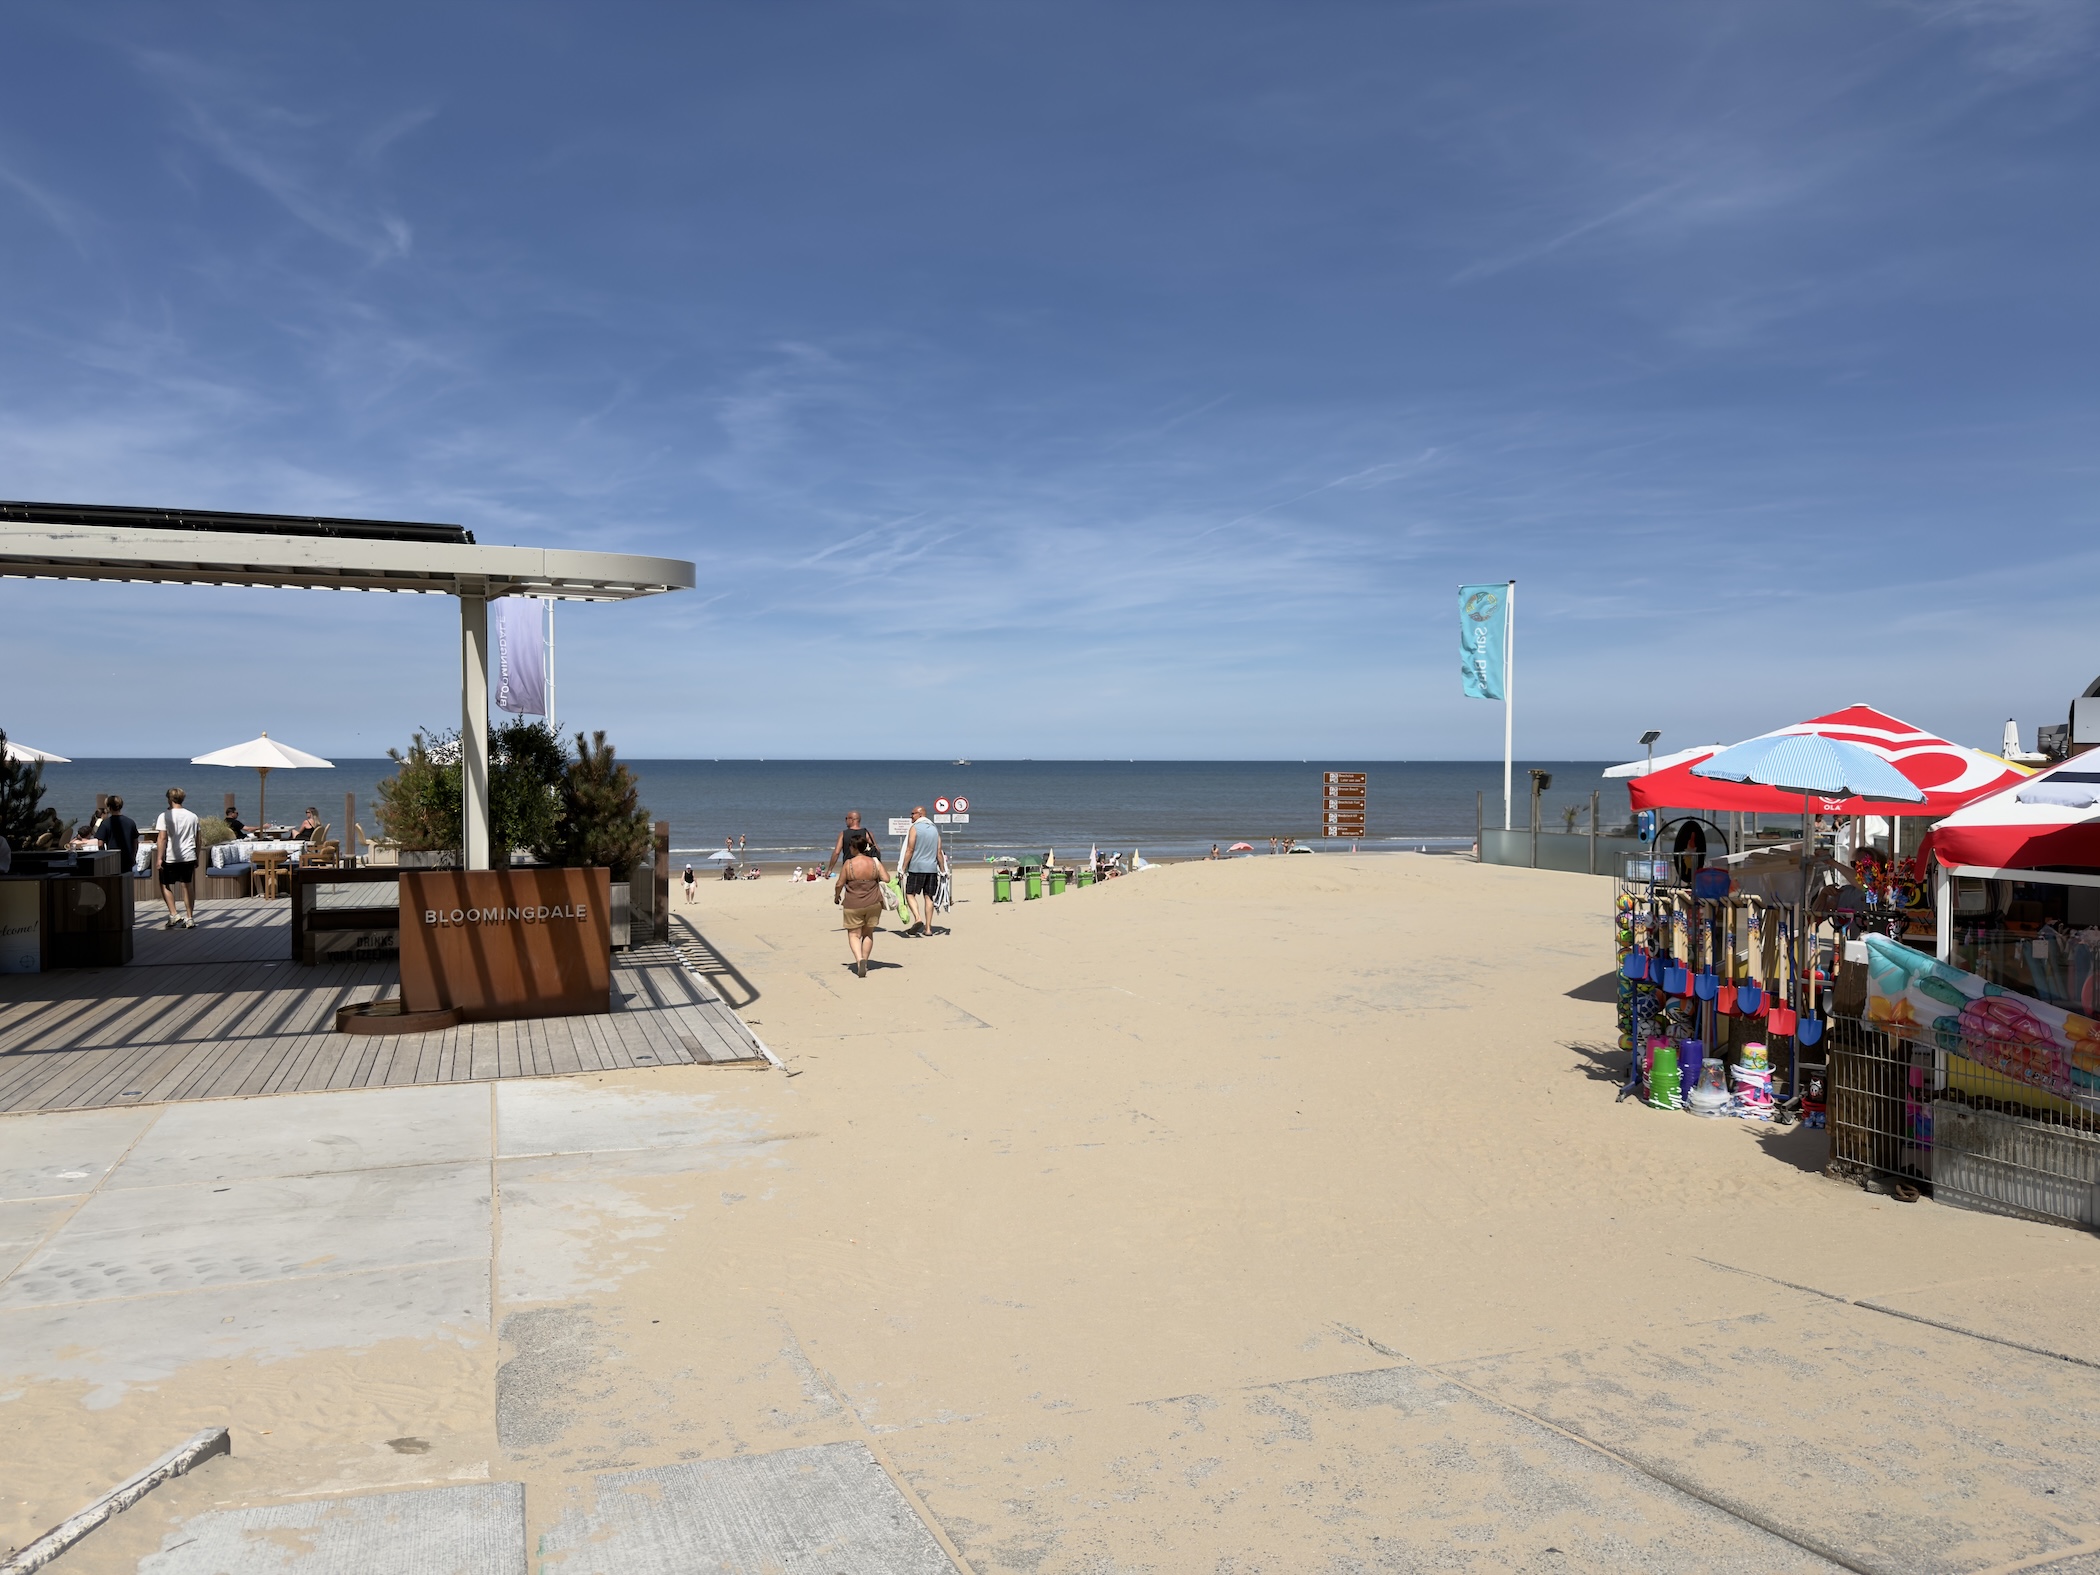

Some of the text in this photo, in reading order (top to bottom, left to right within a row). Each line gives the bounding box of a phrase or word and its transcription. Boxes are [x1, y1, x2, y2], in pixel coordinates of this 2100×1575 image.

[425, 904, 587, 924] BLOOMINGDALE
[356, 936, 394, 947] DRINKS
[327, 950, 353, 961] VOOR
